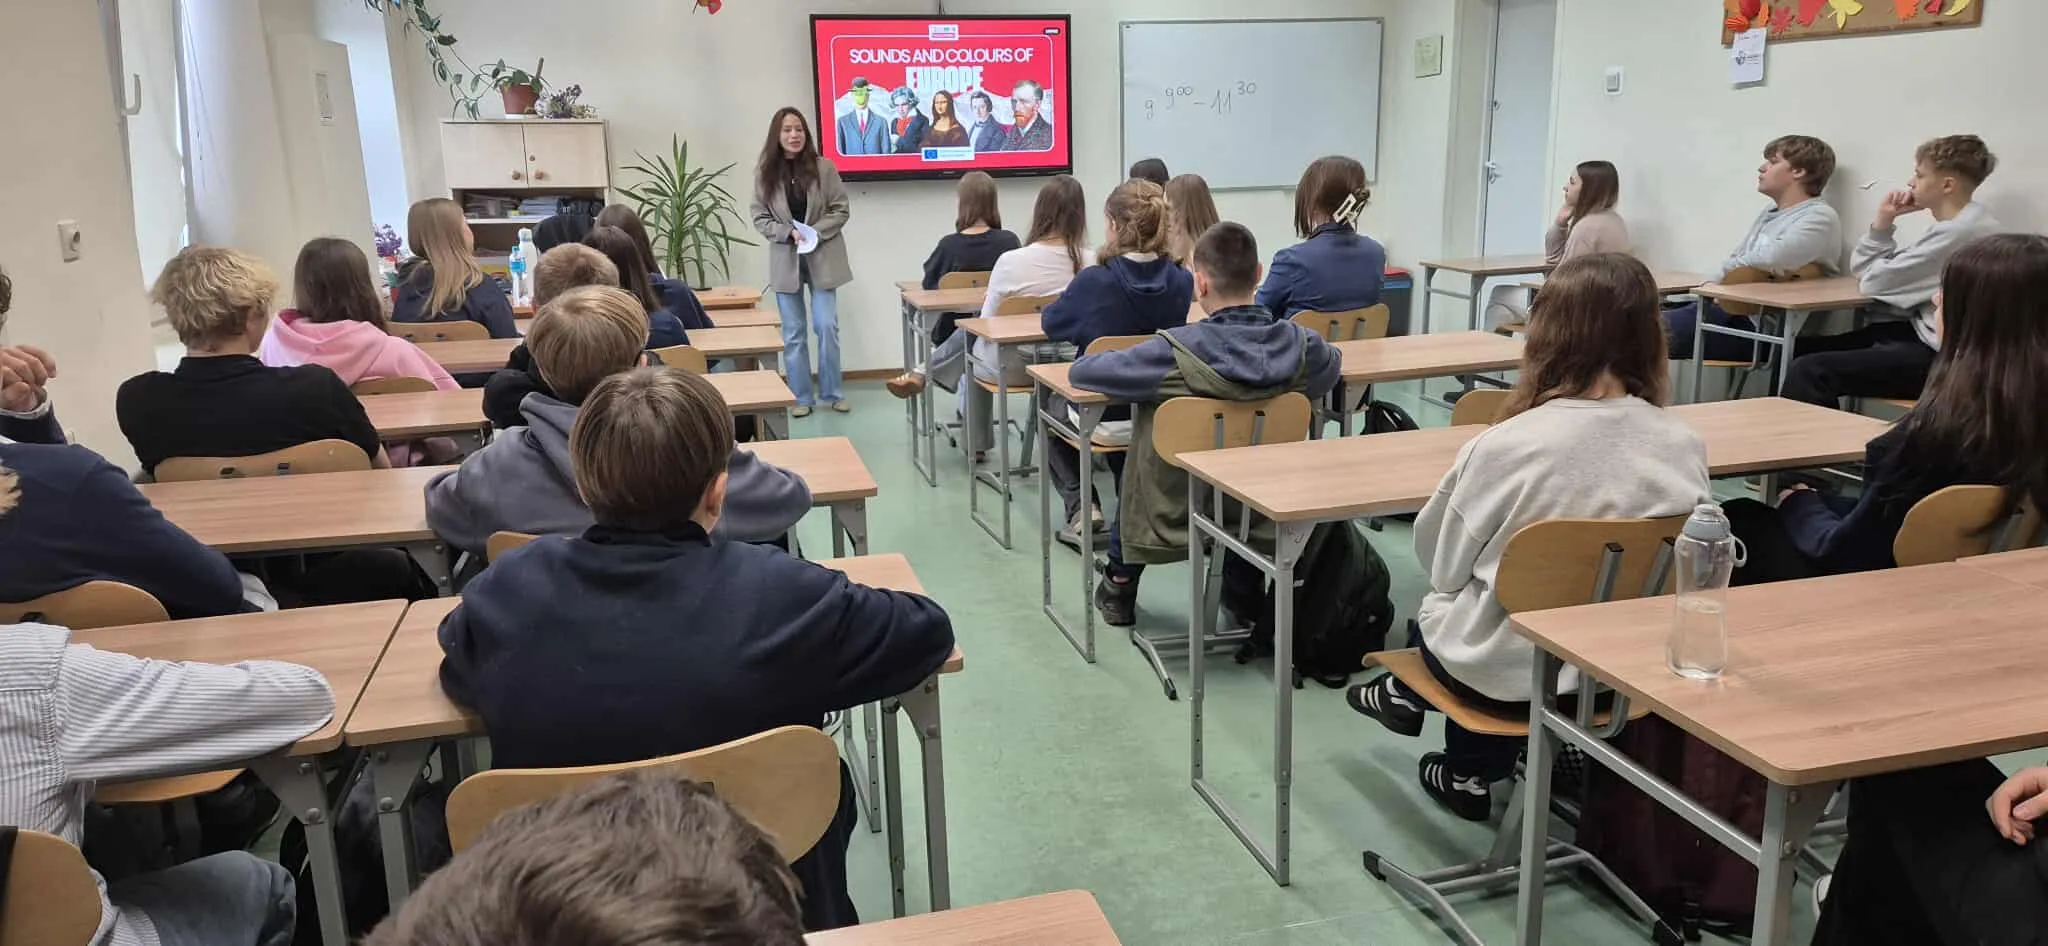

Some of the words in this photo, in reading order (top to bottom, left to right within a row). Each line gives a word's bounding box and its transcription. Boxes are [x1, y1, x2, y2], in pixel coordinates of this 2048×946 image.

[849, 48, 911, 64] SOUNDS
[912, 48, 945, 64] AND
[945, 47, 1013, 64] COLOURS
[1014, 47, 1034, 63] OF
[905, 65, 984, 95] EUROPE
